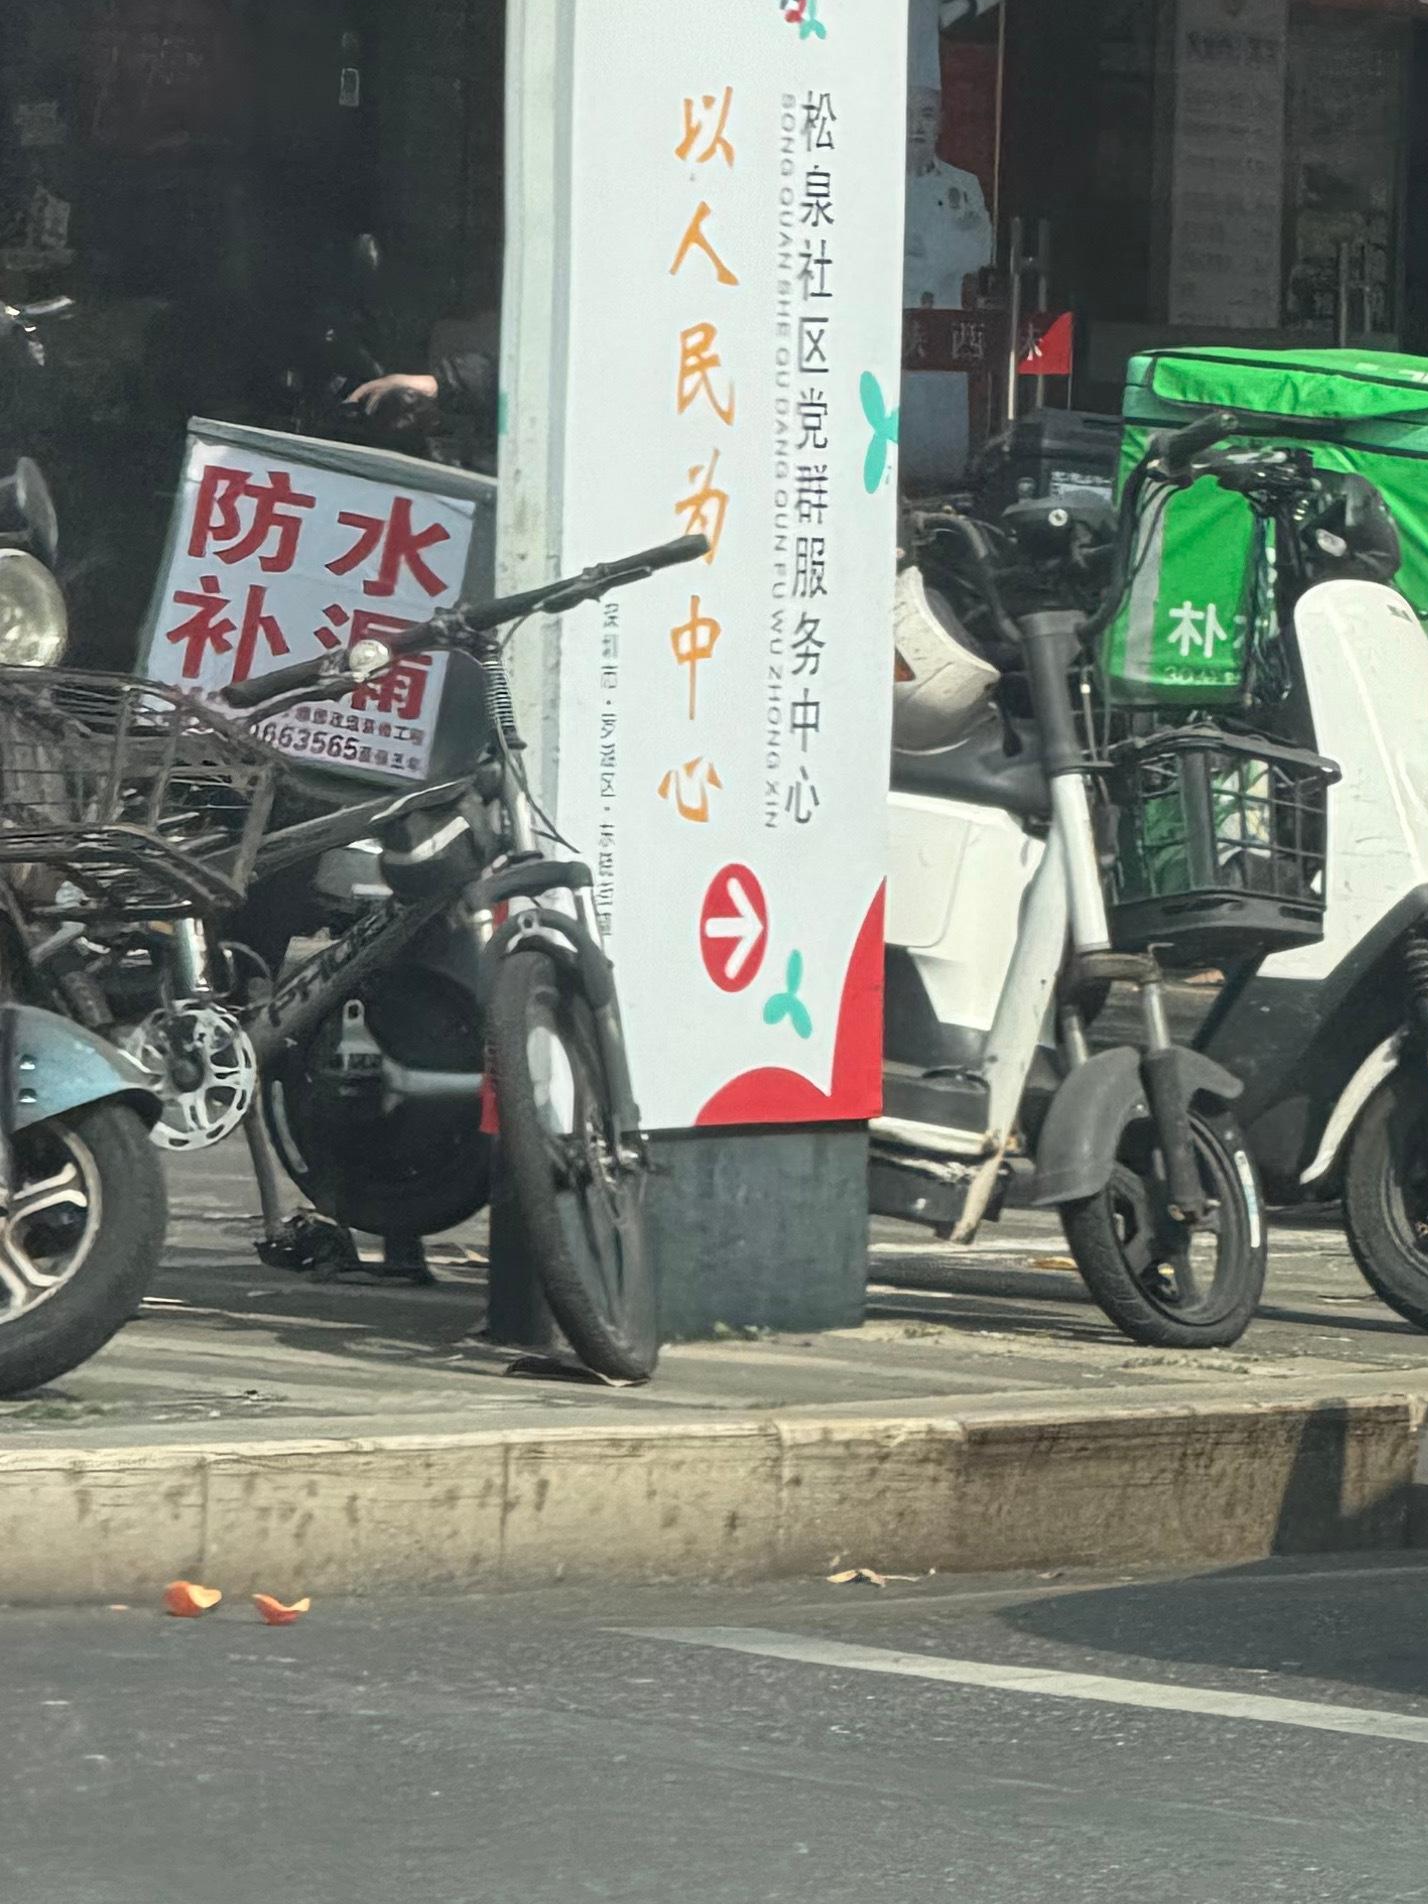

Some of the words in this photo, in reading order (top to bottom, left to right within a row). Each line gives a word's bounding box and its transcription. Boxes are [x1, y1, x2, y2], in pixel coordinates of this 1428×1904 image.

[187, 463, 451, 598] 防水
[655, 85, 741, 824] 以人民为中心
[784, 89, 837, 825] 松泉社区党群服务中心
[1167, 600, 1246, 659] 朴
